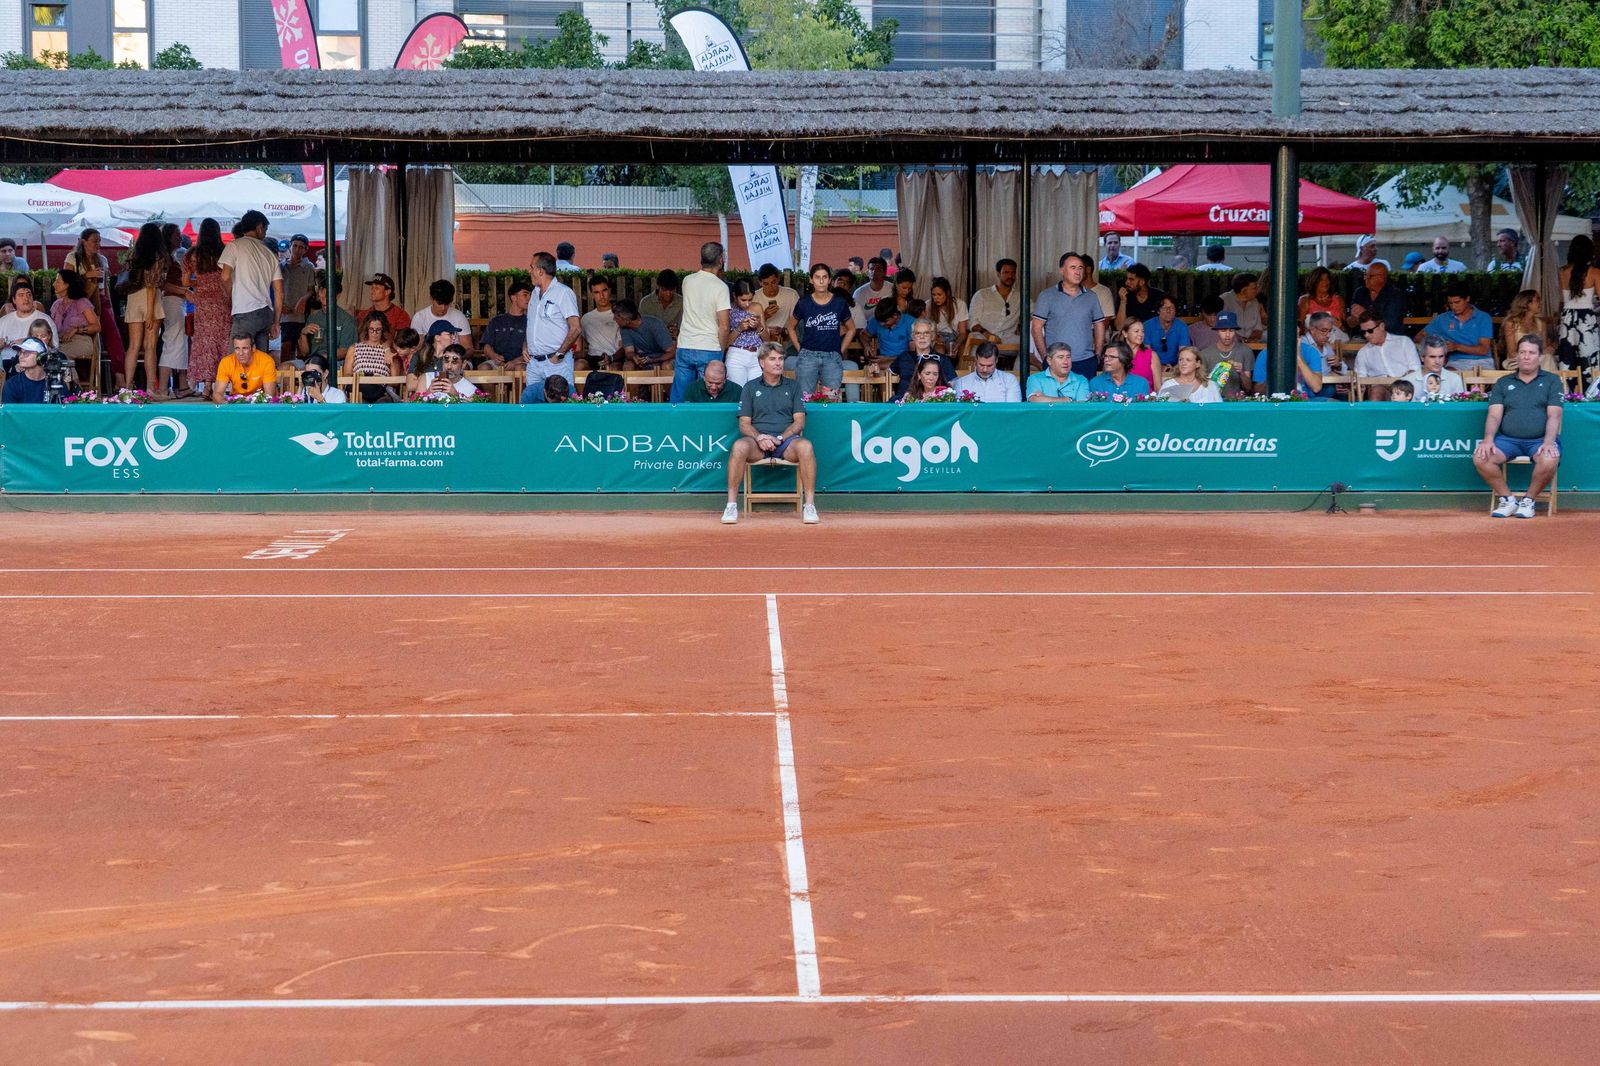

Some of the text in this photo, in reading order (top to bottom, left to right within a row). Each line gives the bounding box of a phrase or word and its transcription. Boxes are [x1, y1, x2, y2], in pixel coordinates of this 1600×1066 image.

[27, 198, 72, 207] Cruzcampo
[263, 202, 305, 212] Cruzcampo
[343, 431, 456, 449] TotalFarma
[554, 434, 729, 453] ANDBANK
[1135, 433, 1278, 452] solocanarias
[1412, 439, 1471, 451] JUAN
[64, 436, 140, 467] FOX
[851, 419, 979, 482] lagoh
[356, 457, 444, 468] total-farma.com
[633, 459, 722, 471] Private Bankers
[112, 468, 140, 479] ESS
[923, 466, 961, 474] SEVILLA
